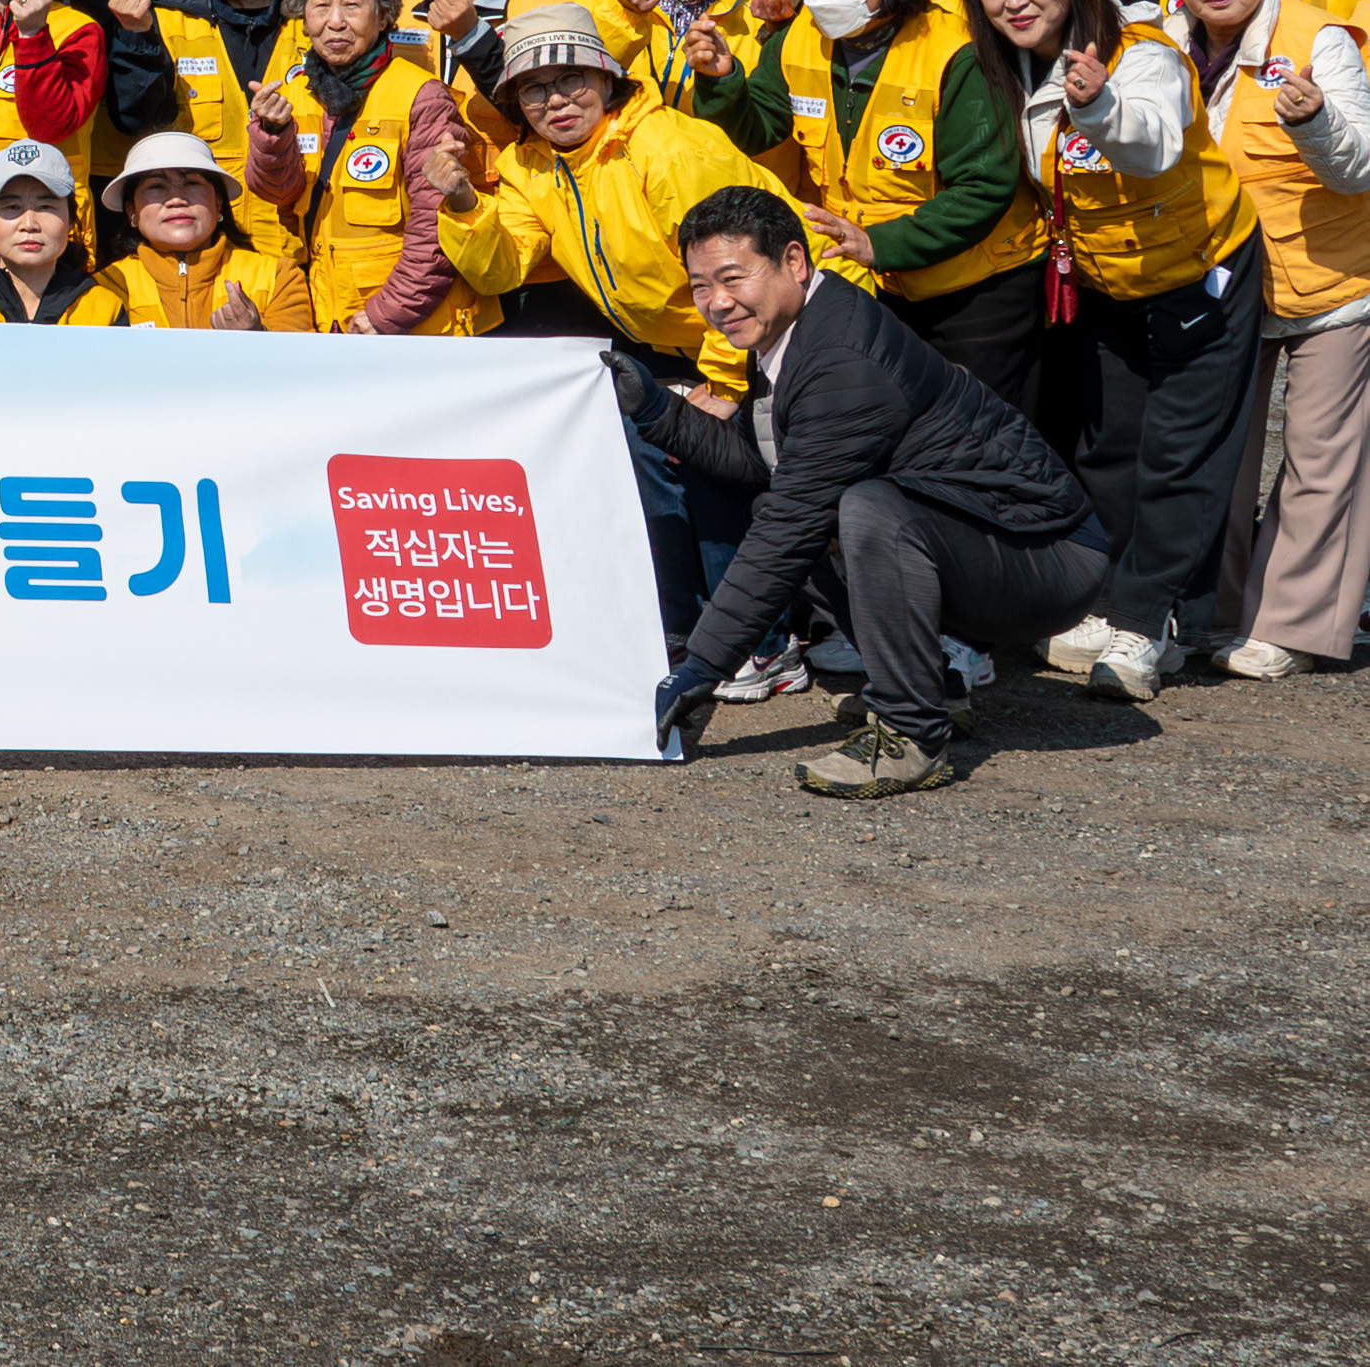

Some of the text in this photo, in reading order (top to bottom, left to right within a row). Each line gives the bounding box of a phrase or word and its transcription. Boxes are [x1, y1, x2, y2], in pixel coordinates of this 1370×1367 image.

[511, 36, 546, 55] ALBATROSS
[549, 34, 566, 42] LIVE
[337, 486, 524, 517] Saving Lives,
[364, 528, 515, 569] 적십자는
[353, 576, 541, 621] 생명입니다
